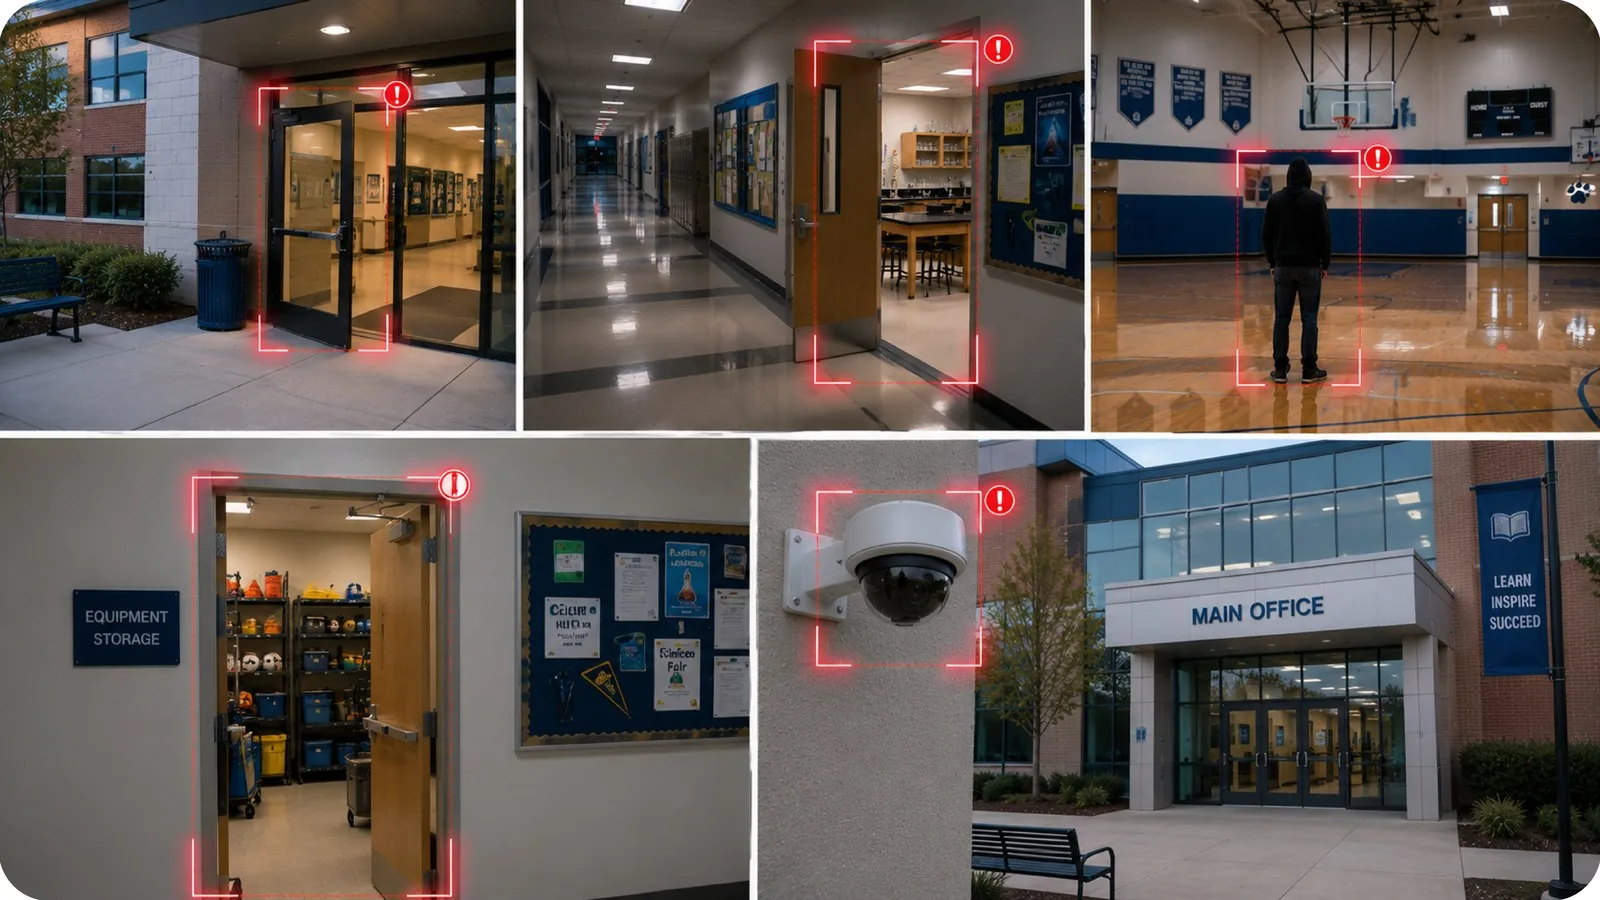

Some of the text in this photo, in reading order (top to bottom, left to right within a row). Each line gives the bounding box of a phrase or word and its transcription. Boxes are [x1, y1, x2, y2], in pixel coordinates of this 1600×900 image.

[1493, 573, 1532, 588] LEARN
[1491, 593, 1537, 609] INSPIRE
[85, 610, 168, 624] EQUIPMENT
[1192, 596, 1325, 625] MAIN OFFICE
[1489, 614, 1541, 630] SUCCEED
[94, 632, 160, 645] STORAGE
